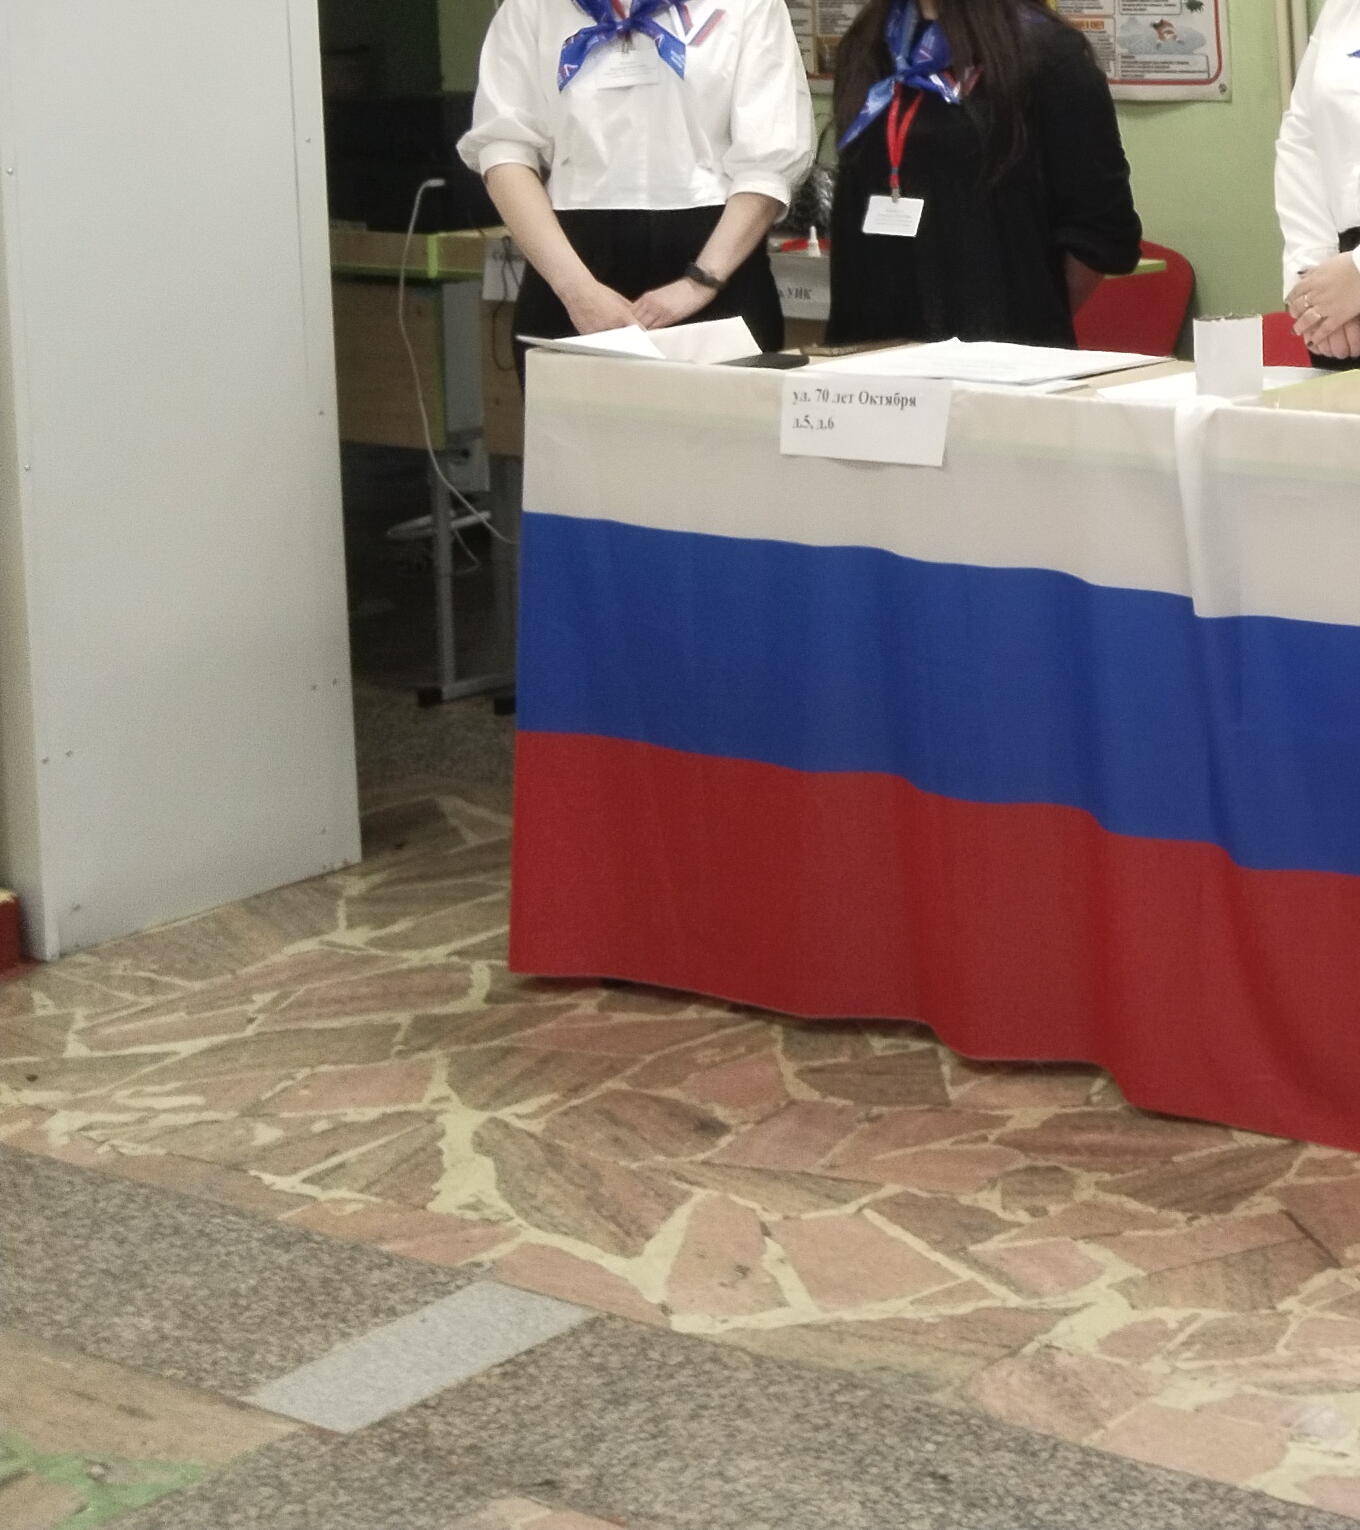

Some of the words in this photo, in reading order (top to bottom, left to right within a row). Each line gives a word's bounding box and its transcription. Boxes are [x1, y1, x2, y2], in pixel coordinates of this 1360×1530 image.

[793, 391, 810, 405] ул.
[815, 388, 829, 402] 70
[832, 392, 853, 403] лет
[858, 391, 916, 410] Октября
